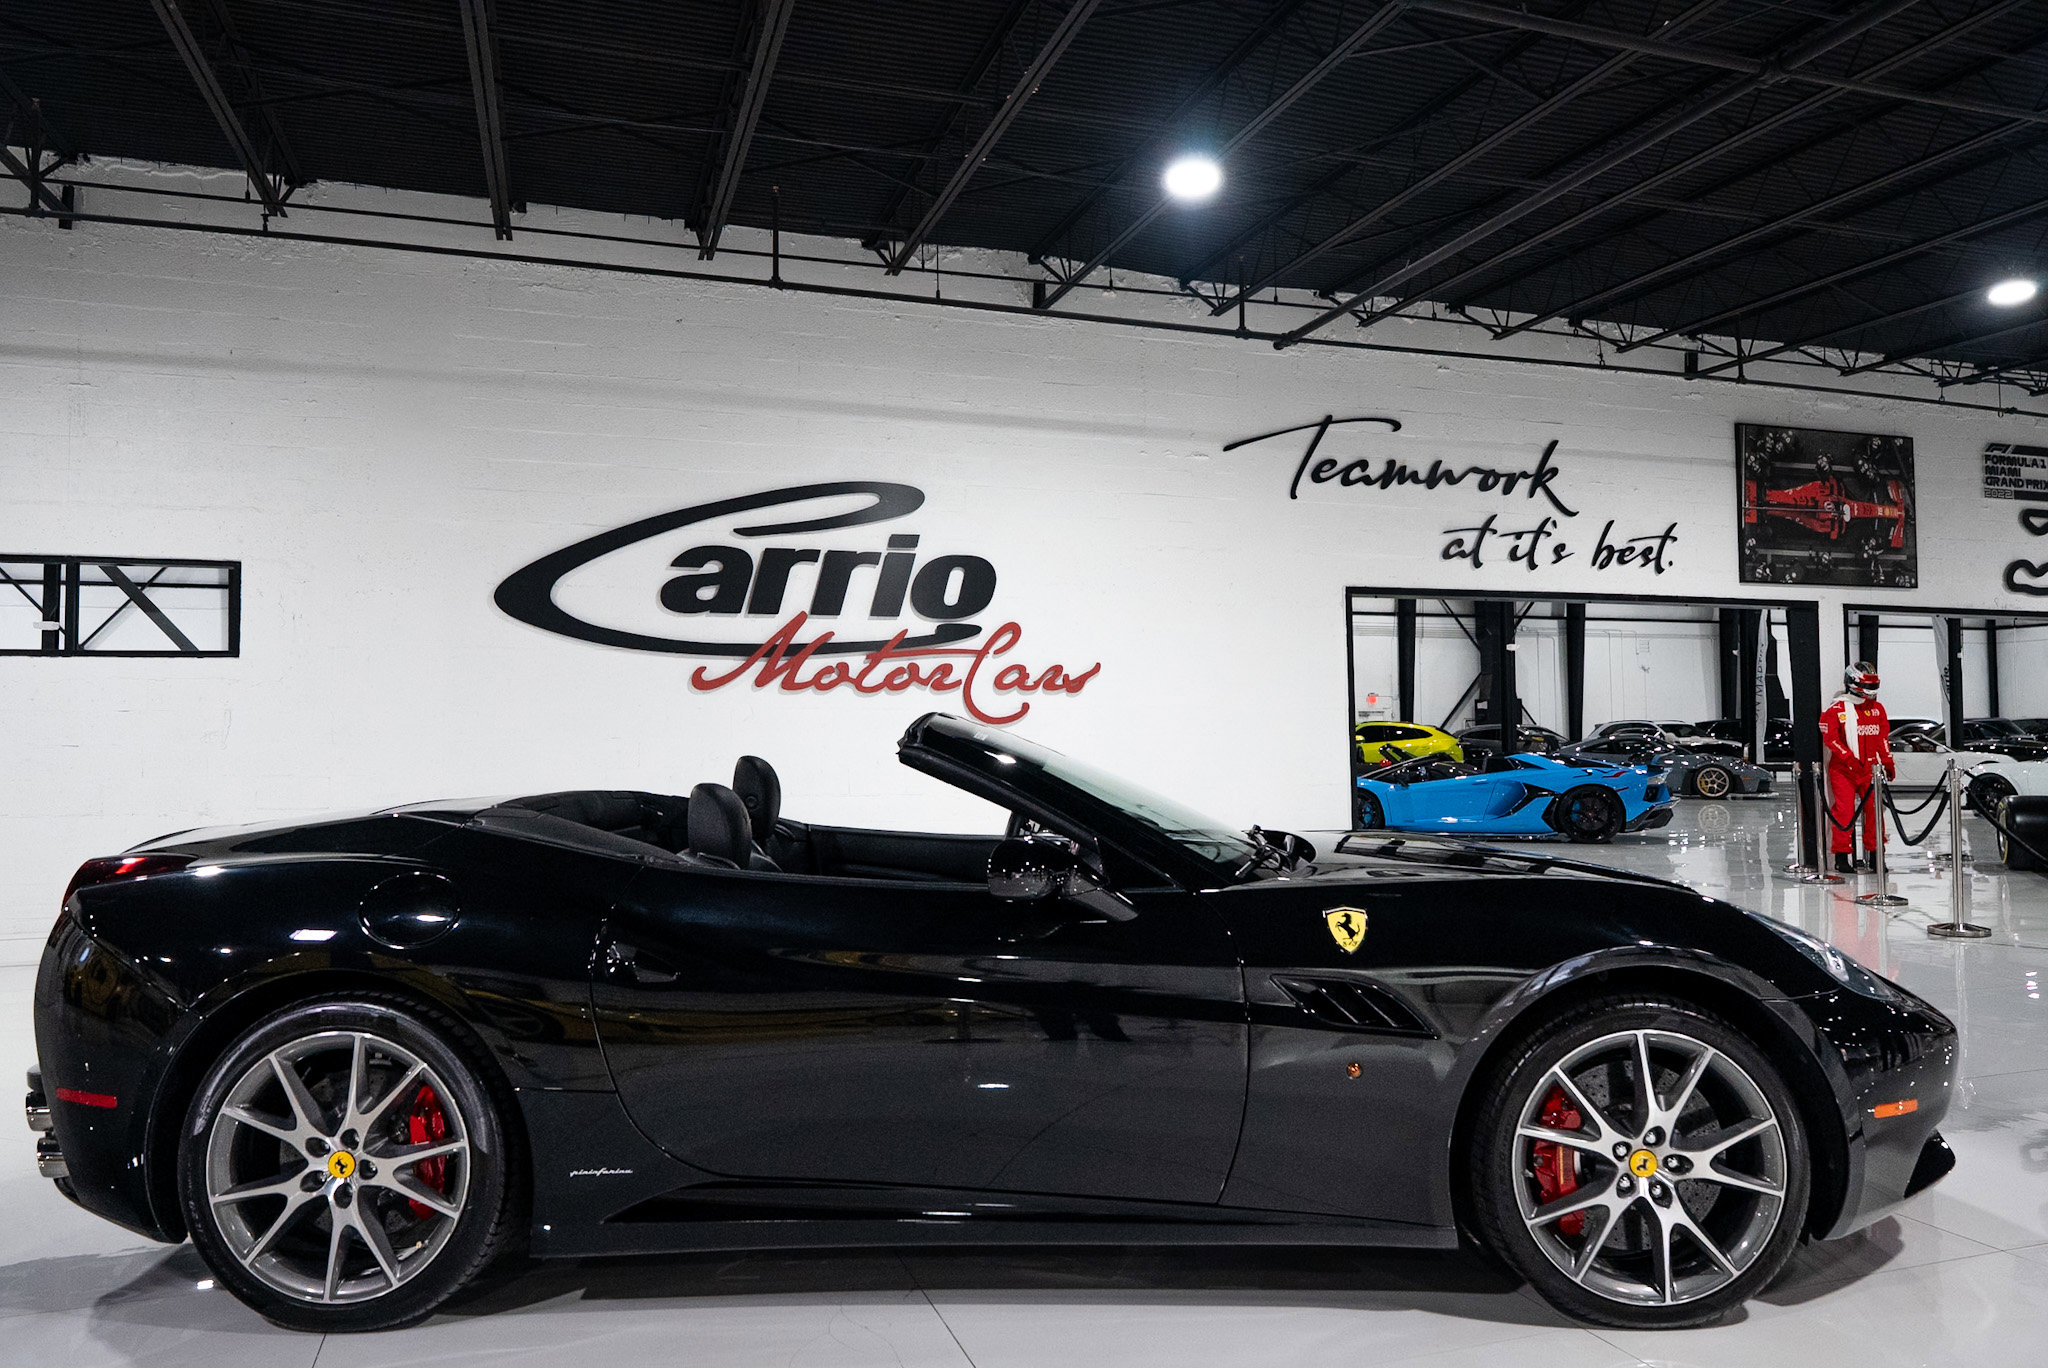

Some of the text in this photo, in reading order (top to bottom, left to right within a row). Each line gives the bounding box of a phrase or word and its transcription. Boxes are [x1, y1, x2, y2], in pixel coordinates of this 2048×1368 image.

[1223, 415, 1579, 518] Teamwork
[1984, 454, 2047, 469] FORMULA 1
[1984, 464, 2022, 477] MIAMI
[1985, 476, 2024, 488] GRAND
[1984, 487, 2014, 499] 2022
[1443, 513, 1678, 575] at it's best.
[493, 481, 998, 659] Carrio
[568, 1167, 634, 1178] pininfarina
